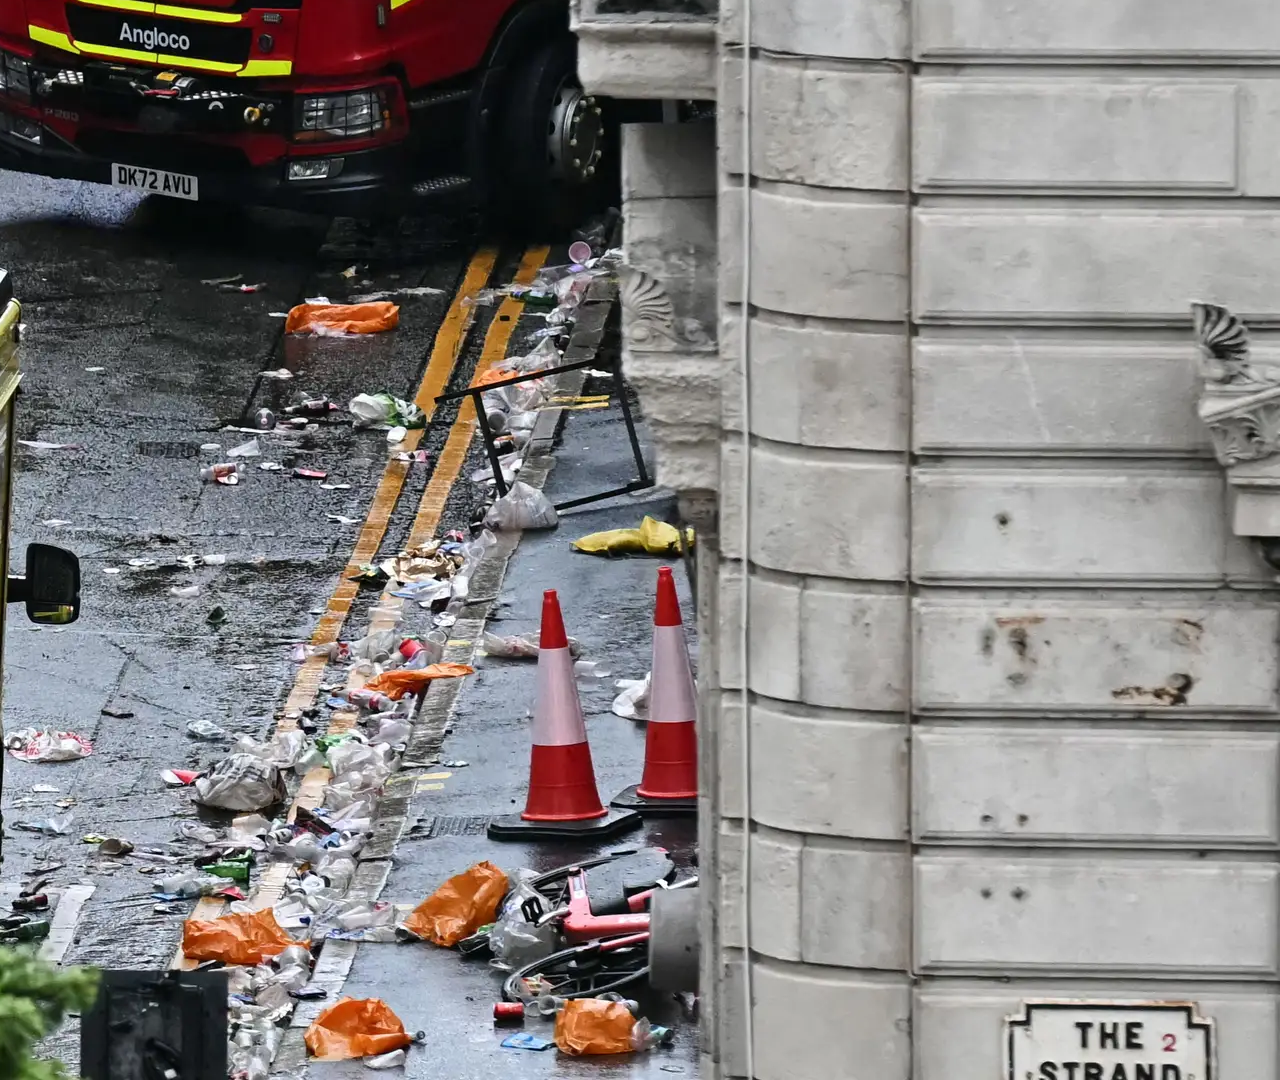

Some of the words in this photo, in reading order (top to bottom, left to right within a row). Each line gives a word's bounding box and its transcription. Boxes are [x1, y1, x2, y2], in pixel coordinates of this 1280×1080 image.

[119, 22, 190, 51] Angloco
[117, 166, 161, 190] DK72
[162, 177, 192, 196] AVU
[1074, 1021, 1145, 1050] THE
[1161, 1033, 1178, 1052] 2
[1038, 1060, 1182, 1080] STRAND
